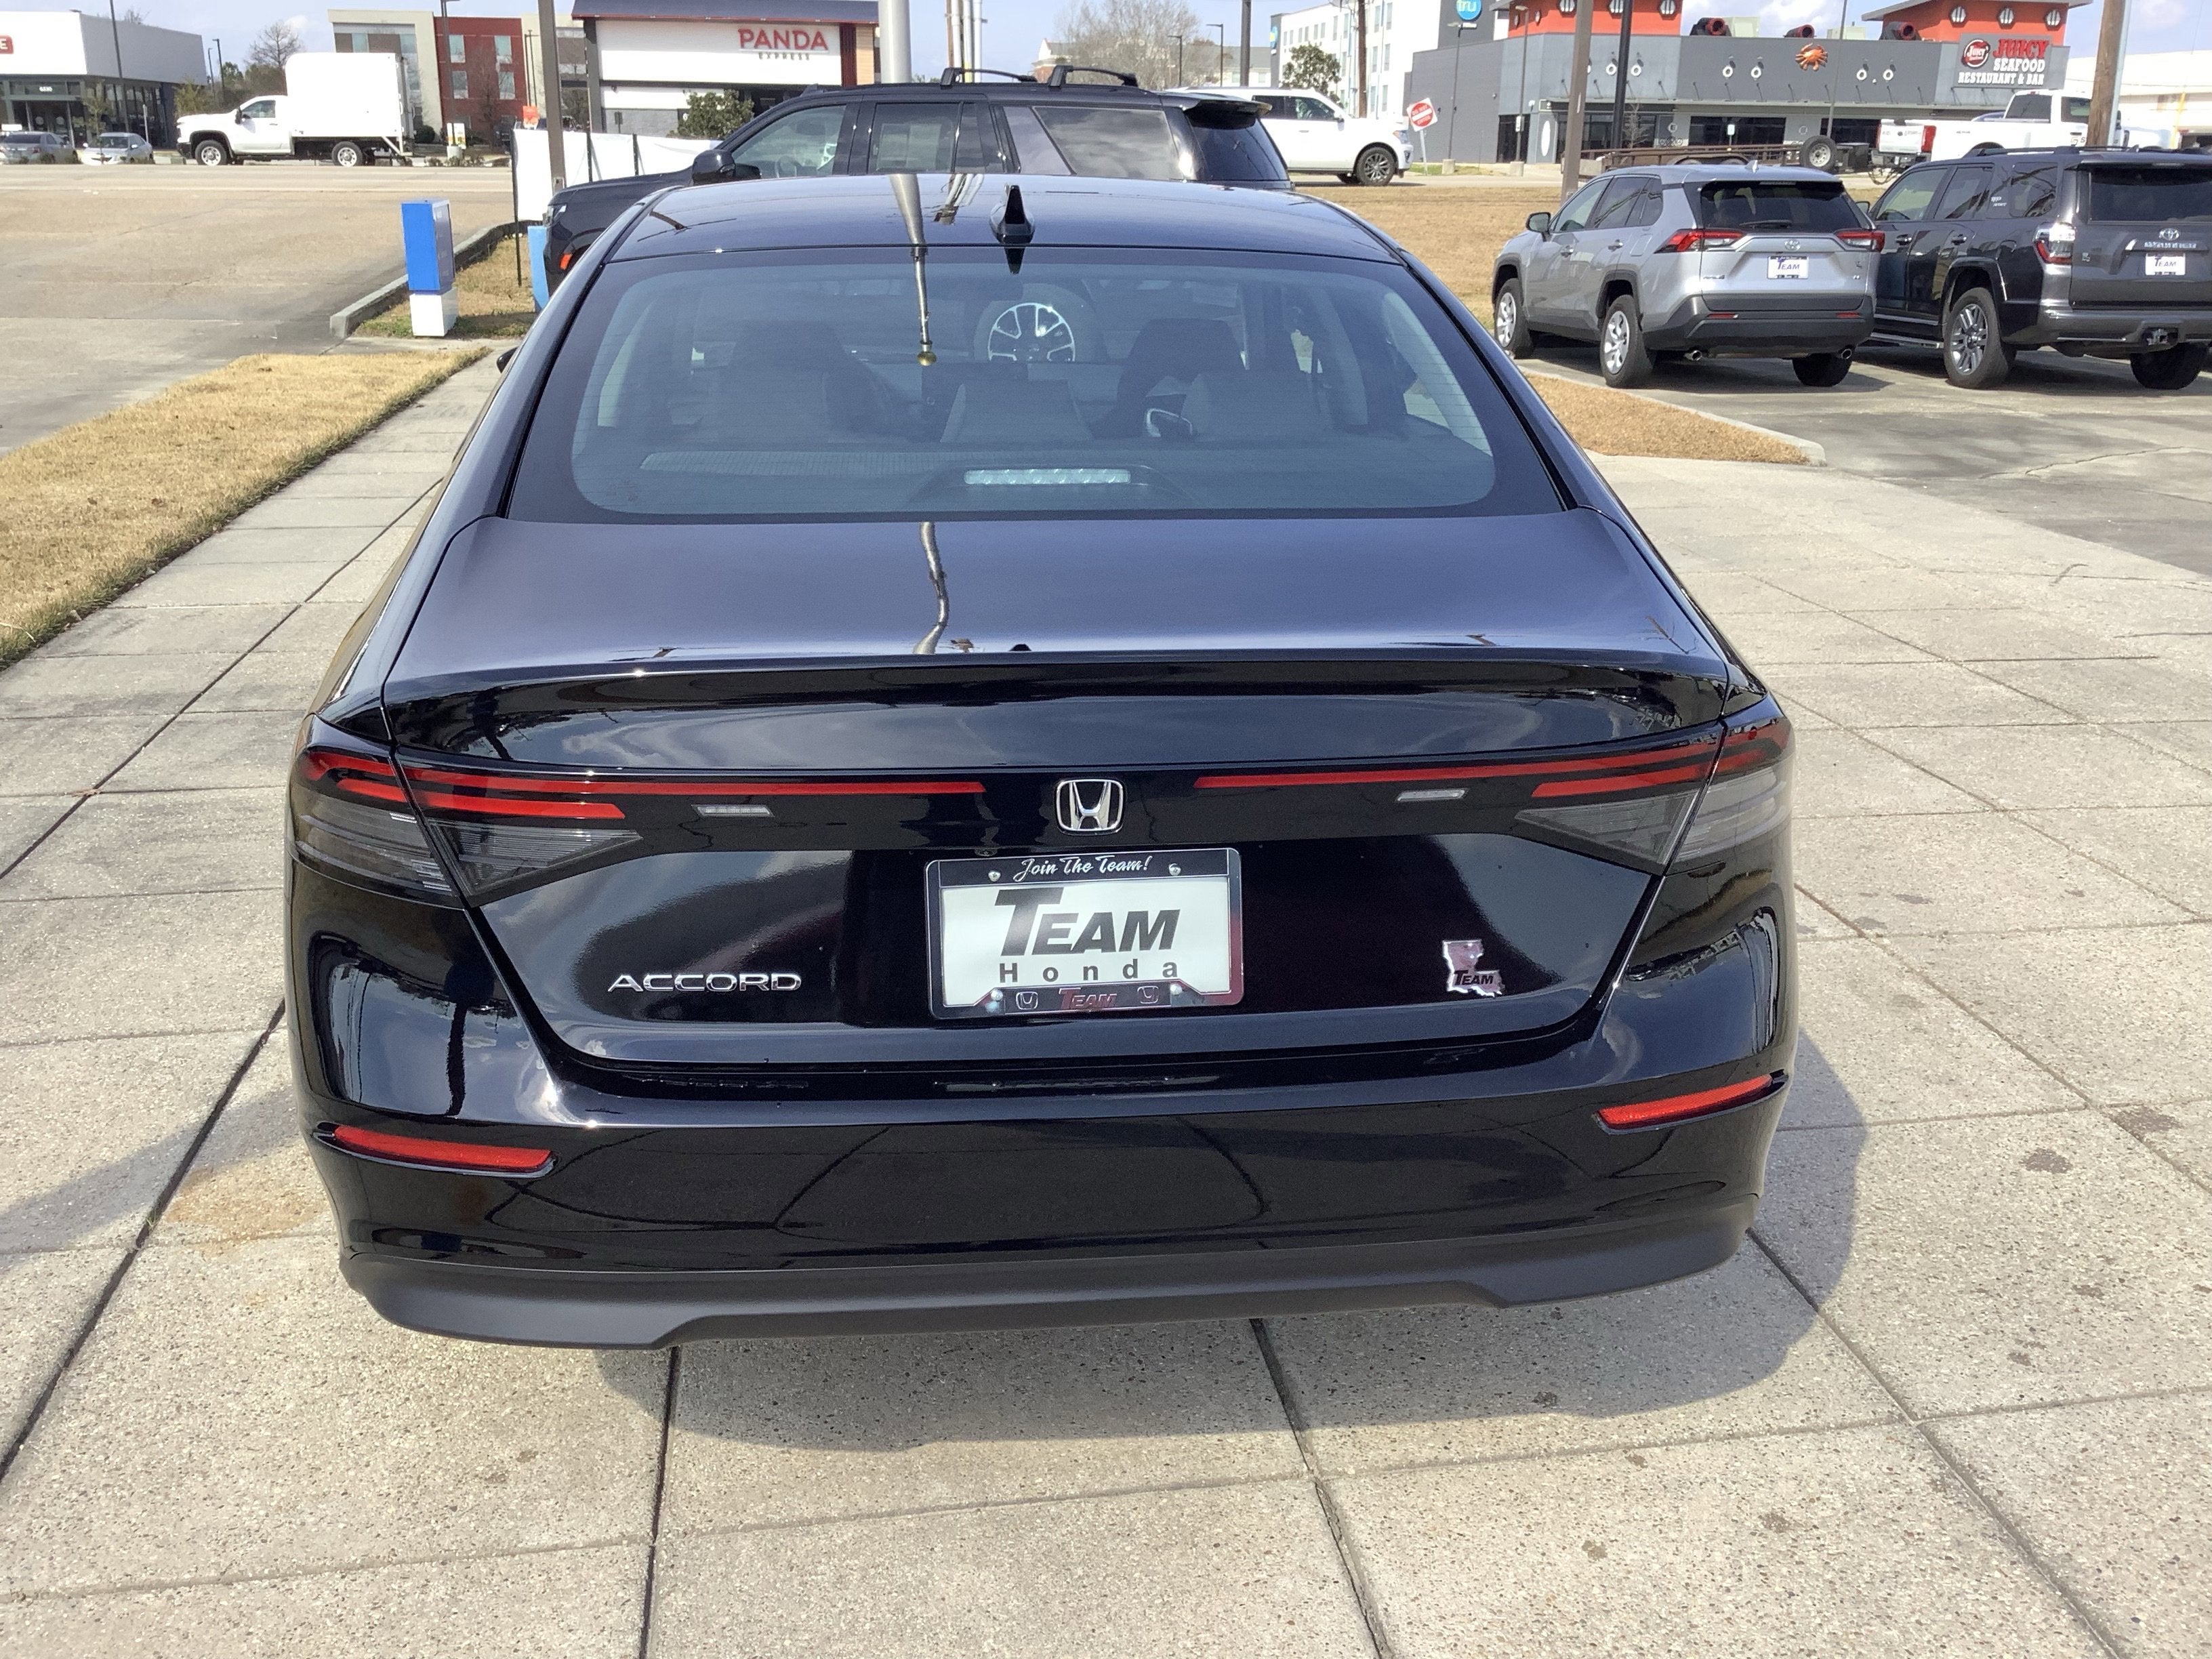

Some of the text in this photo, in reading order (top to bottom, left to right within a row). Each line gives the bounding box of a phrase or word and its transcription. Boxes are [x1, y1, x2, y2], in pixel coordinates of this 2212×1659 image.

[738, 28, 828, 50] PANDA
[759, 52, 810, 60] EXPRESS
[1993, 39, 2049, 59] JUICY
[1993, 58, 2045, 73] SEAFOOD
[1958, 72, 2044, 85] RESTAURANT & BAR
[1778, 257, 1800, 270] TEAM
[2154, 257, 2177, 267] TEAM
[1012, 855, 1153, 882] Join The Team!
[994, 887, 1181, 956] TEAM
[999, 959, 1179, 983] Honda
[1454, 970, 1494, 985] TEAM
[608, 973, 802, 991] ACCORD
[1059, 987, 1118, 1009] TEAM
